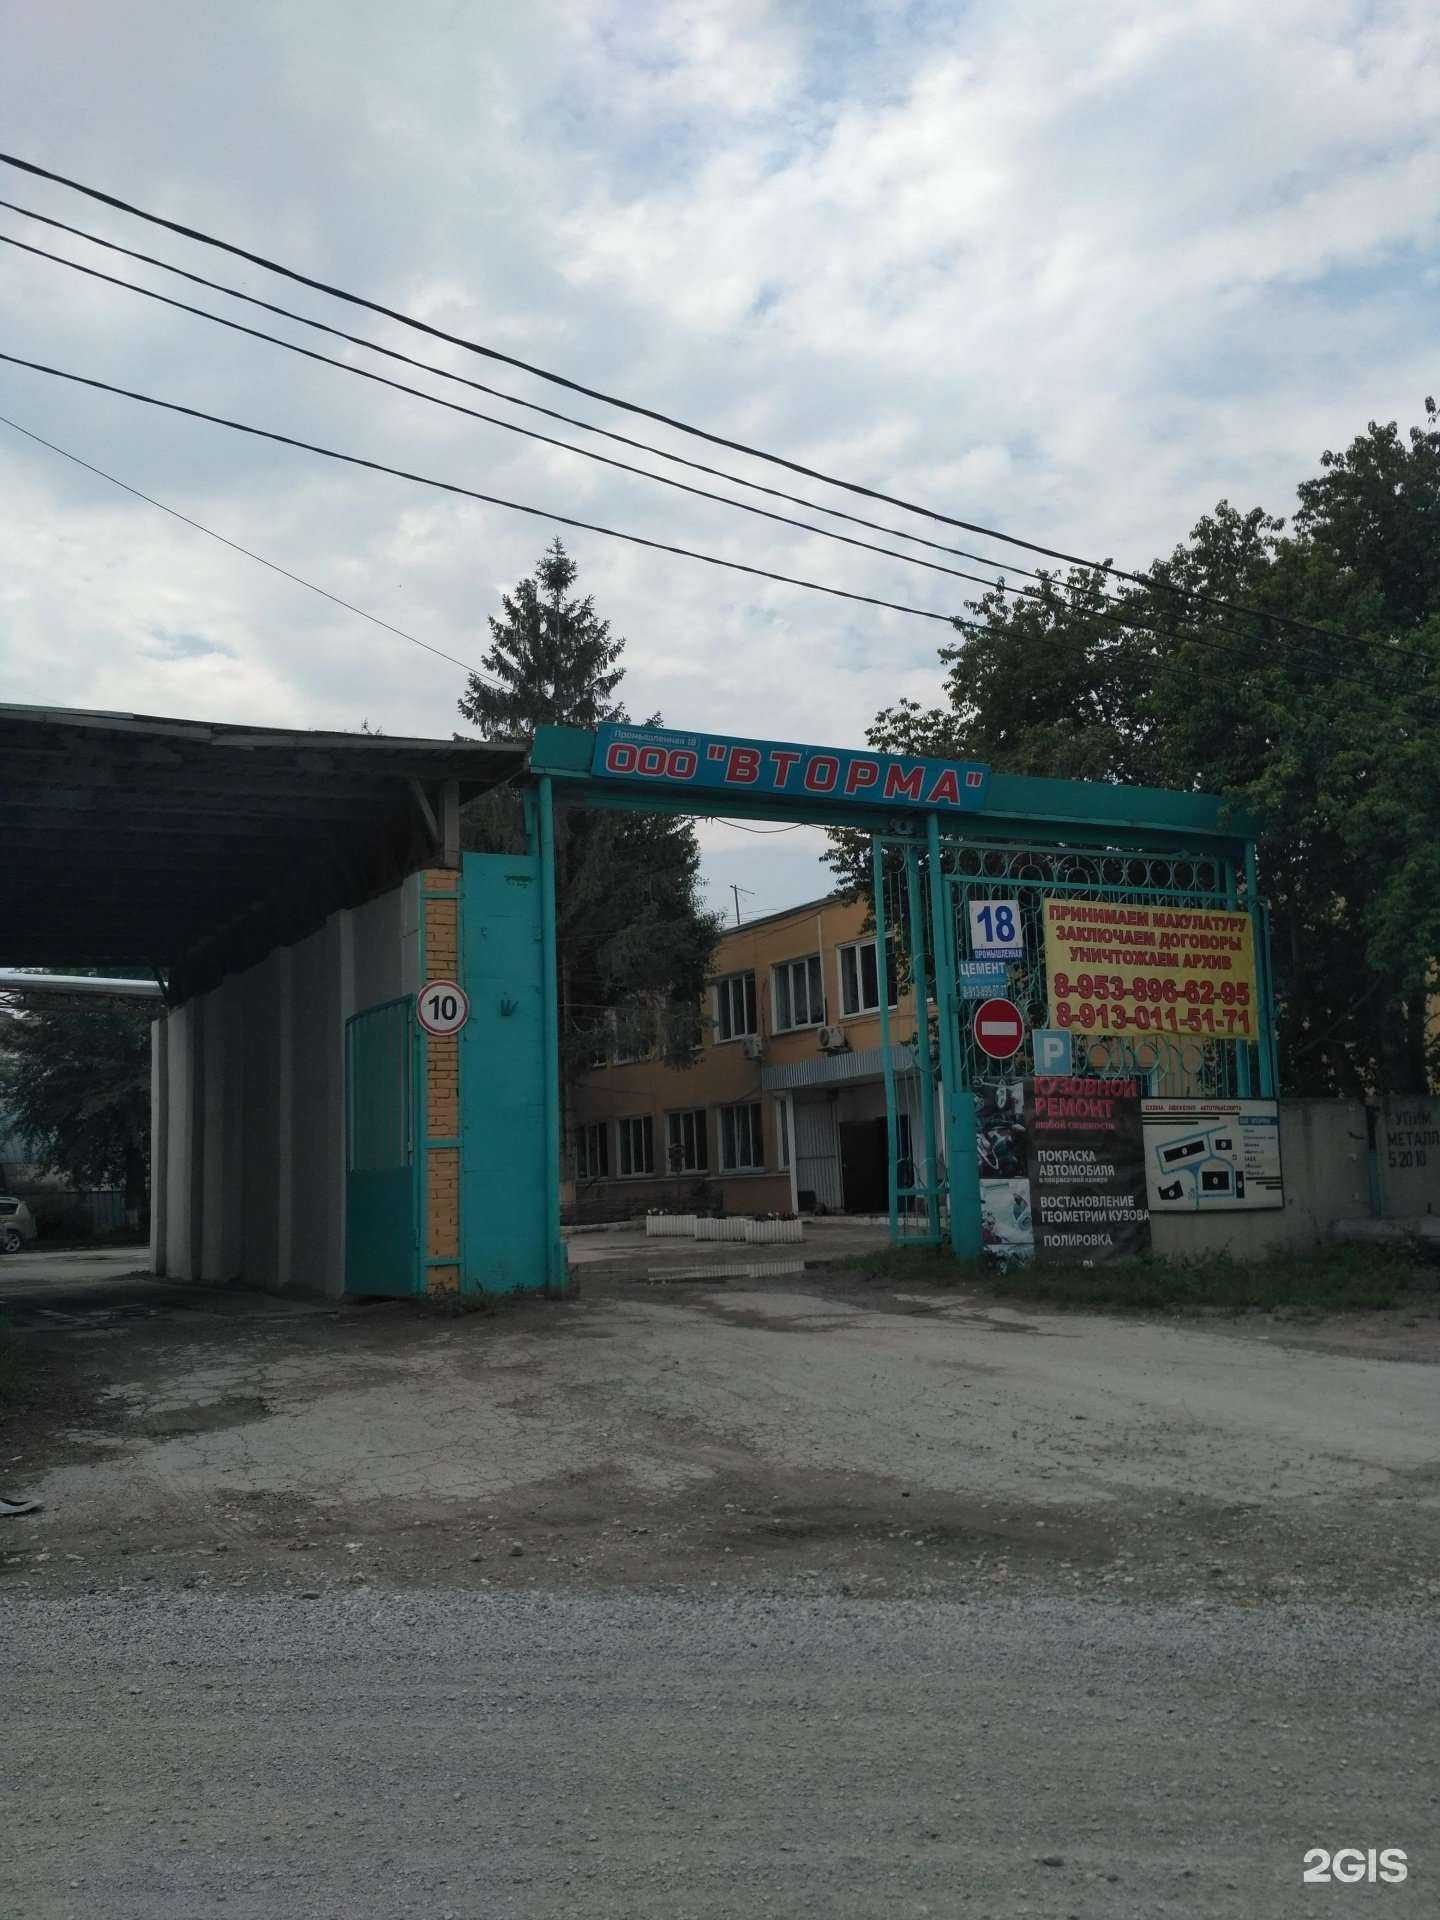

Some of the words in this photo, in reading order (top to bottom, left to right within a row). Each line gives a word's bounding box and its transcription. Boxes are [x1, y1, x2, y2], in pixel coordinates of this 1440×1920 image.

[606, 742, 698, 780] ООО
[706, 743, 983, 806] "ВТОРМА"
[976, 905, 1016, 943] 18
[1049, 904, 1149, 926] ПРИНИМАЕМ
[1152, 912, 1248, 933] МАКУЛАТУРУ
[1055, 925, 1156, 946] ЗАКЛЮЧАЕМ
[1159, 932, 1243, 951] ДОГОВОРЫ
[960, 961, 1006, 977] ЦЕМЕНТ
[1069, 946, 1179, 968] УНИЧТОЖАЕМ
[1182, 953, 1233, 970] АРХИВ
[1053, 972, 1250, 1006] 8-953-896-62-95
[428, 995, 458, 1020] 10
[1055, 1002, 1250, 1034] 8-913-011-51-71
[1042, 1037, 1065, 1068] P
[1034, 1097, 1115, 1118] РЕМОНТ
[1037, 1150, 1097, 1162] ПОКРАСКА
[1039, 1164, 1115, 1177] АВТОМОБИЛЯ
[1040, 1195, 1135, 1208] ВОСТАНОВЛЕНИЕ
[1041, 1210, 1107, 1223] ГЕОМЕТРИИ
[1109, 1209, 1151, 1222] КУЗОВА
[1043, 1233, 1113, 1247] ПОЛИРОВКА
